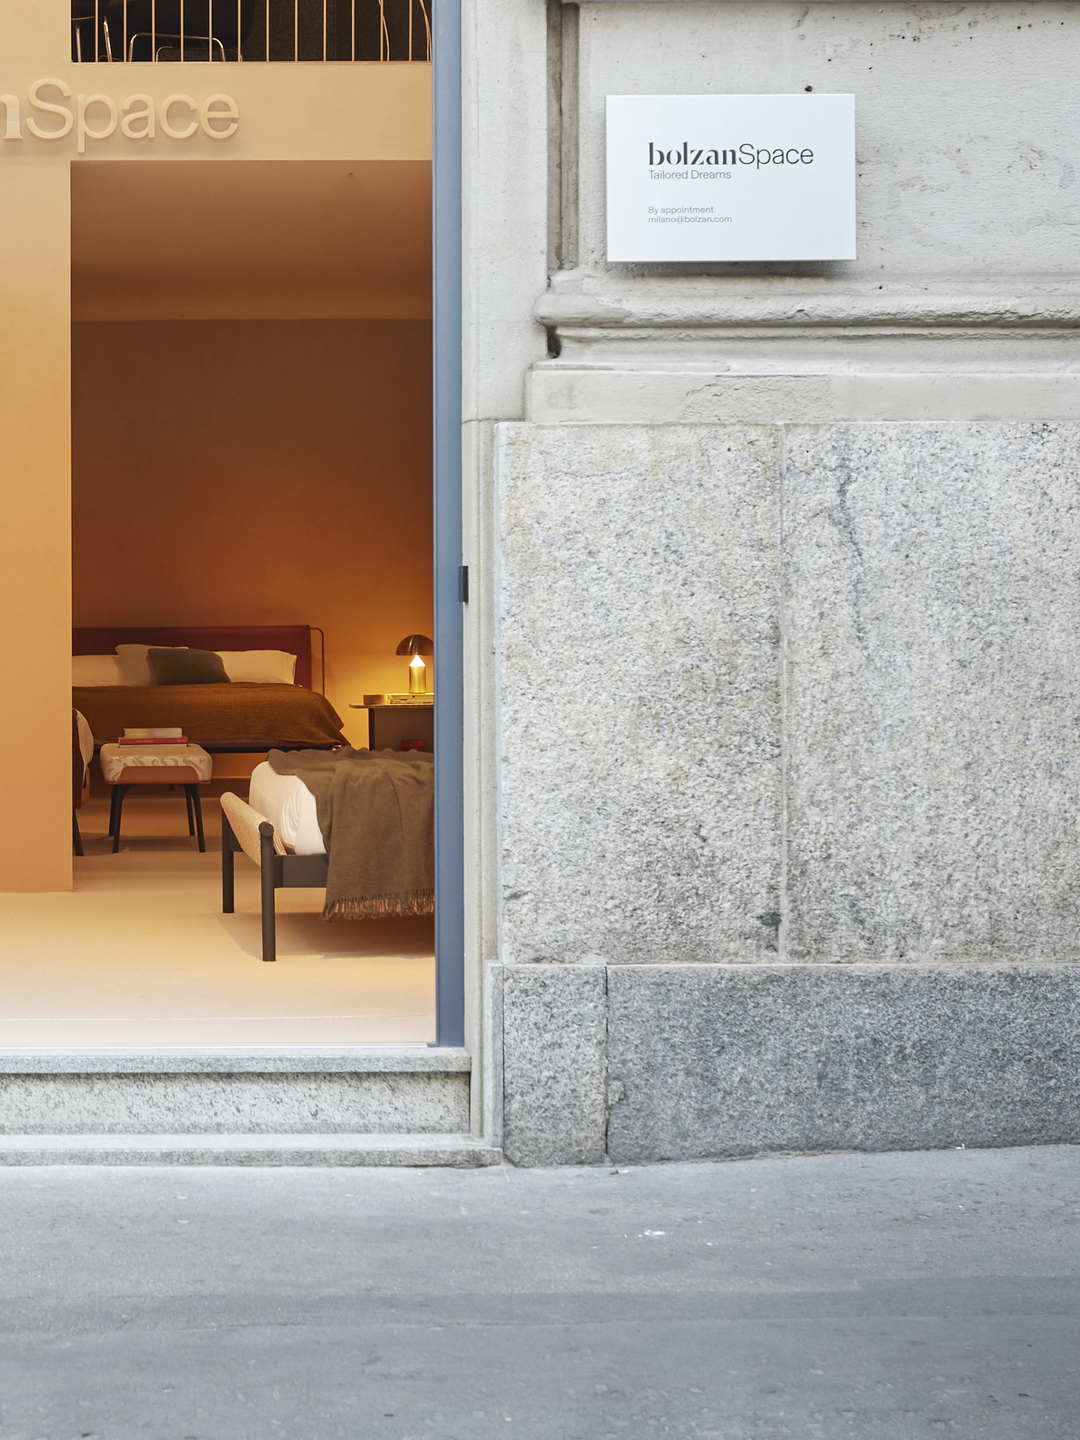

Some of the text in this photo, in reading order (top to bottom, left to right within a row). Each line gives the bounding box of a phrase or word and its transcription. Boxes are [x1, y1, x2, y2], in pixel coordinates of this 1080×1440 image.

[648, 141, 814, 170] bolzanSpace
[648, 169, 732, 180] Tailored Dreams
[648, 206, 714, 216] By appointment
[648, 215, 733, 225] milano@bolzan.com
